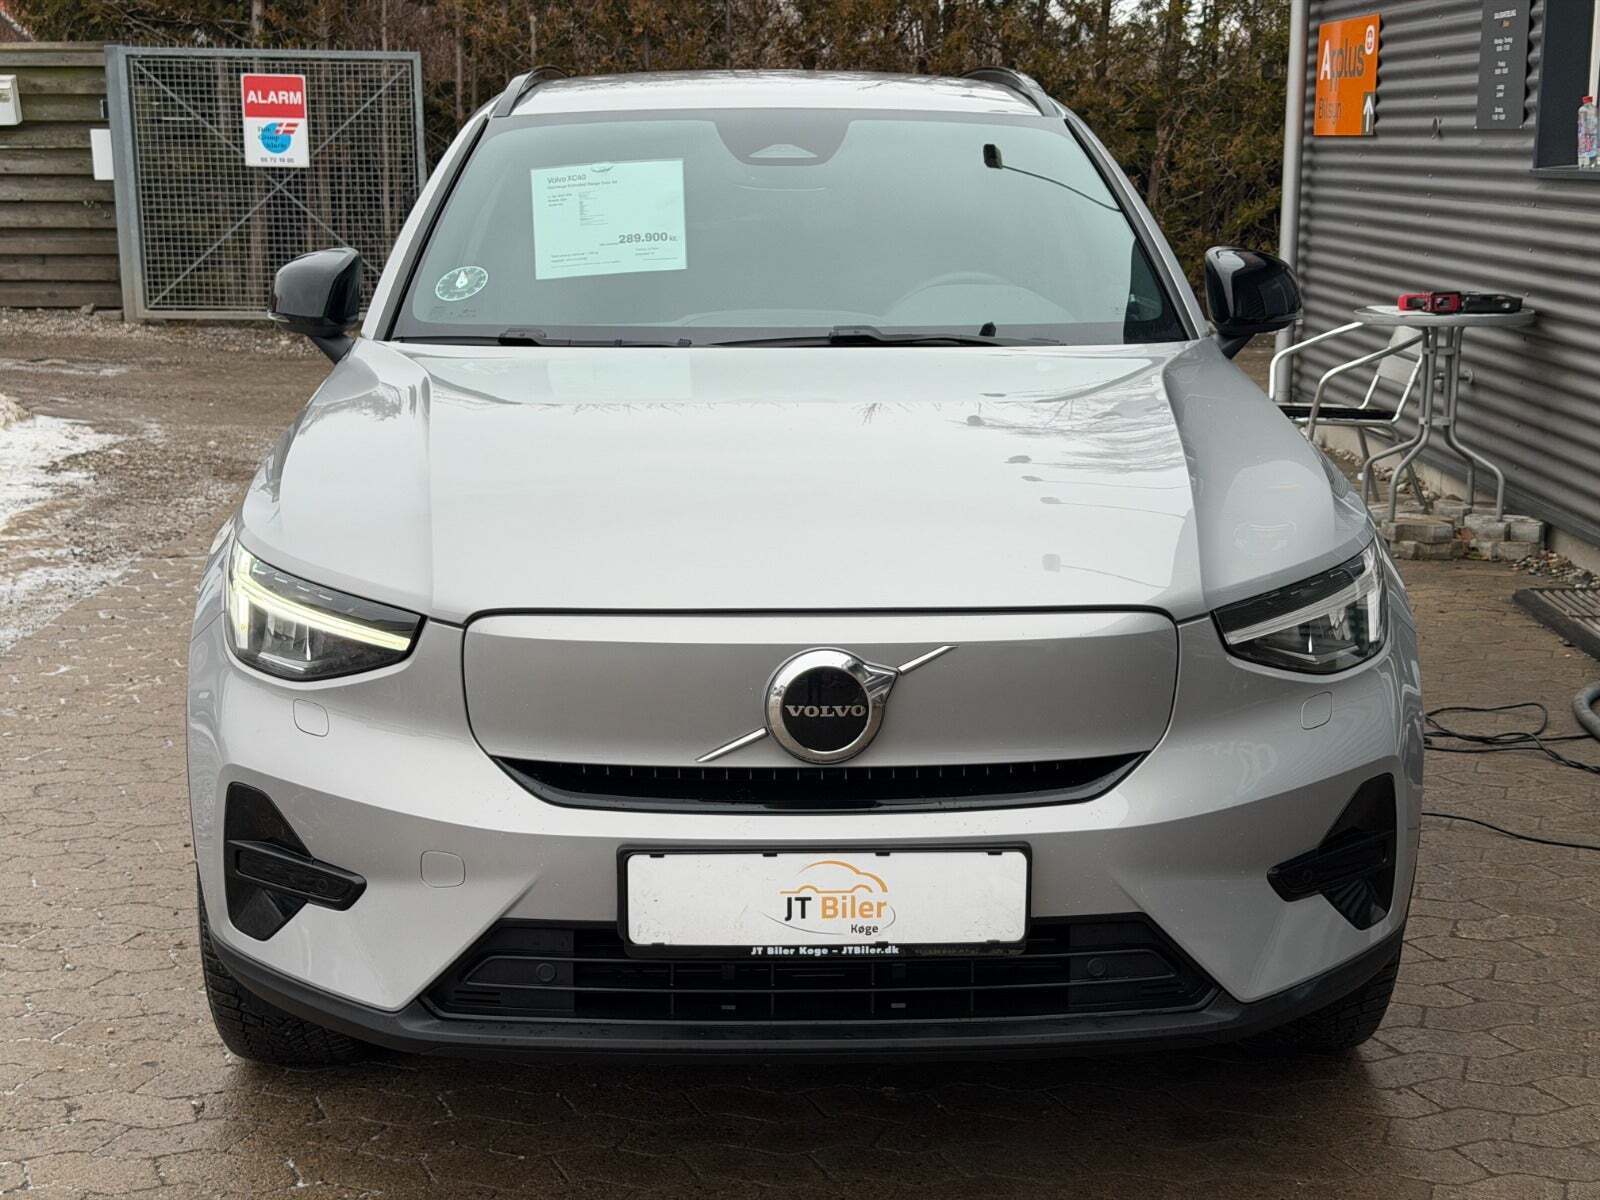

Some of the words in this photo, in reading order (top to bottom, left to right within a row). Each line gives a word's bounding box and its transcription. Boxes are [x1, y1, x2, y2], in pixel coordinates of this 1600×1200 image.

[246, 90, 302, 105] ALARM
[547, 176, 567, 184] Volvo
[618, 232, 668, 244] 289.900
[785, 704, 867, 718] VOLVO
[784, 896, 812, 922] JT
[820, 895, 887, 919] Biler
[851, 924, 879, 936] Køge
[751, 947, 763, 955] JT
[767, 946, 795, 955] Biler
[841, 945, 899, 955] JTBiler.dk
